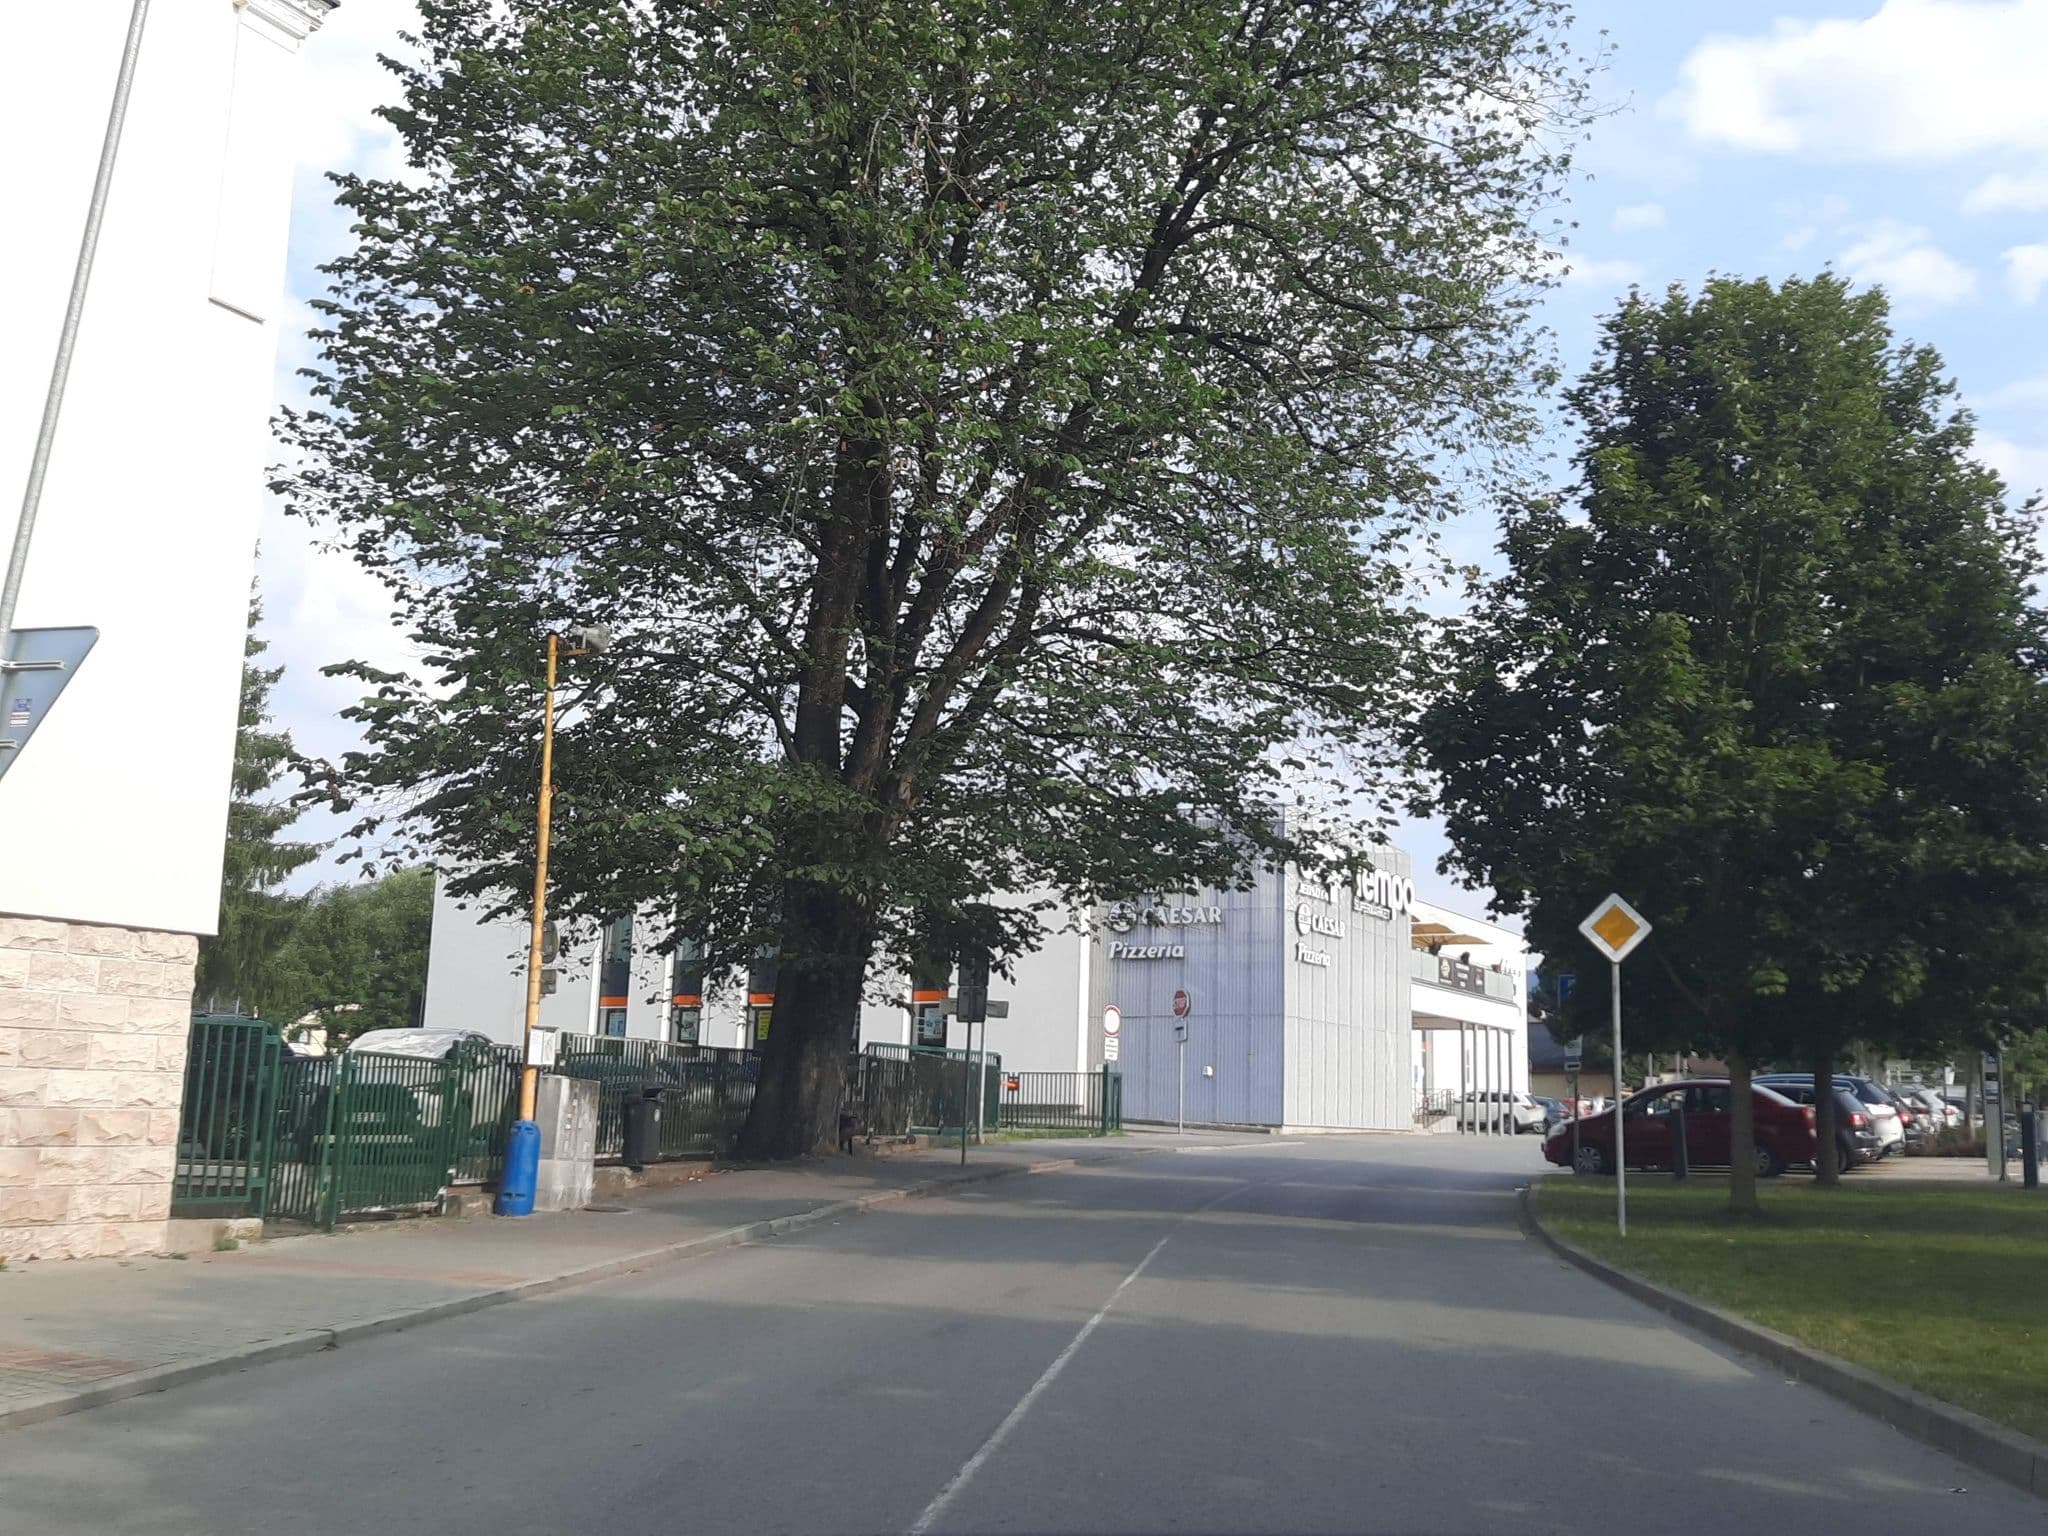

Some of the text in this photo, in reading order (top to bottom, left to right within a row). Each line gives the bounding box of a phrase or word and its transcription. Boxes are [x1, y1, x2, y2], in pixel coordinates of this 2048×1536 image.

[1312, 914, 1346, 938] CAESAR
[1108, 940, 1185, 959] Pizzeria
[1298, 942, 1331, 967] Pizzeria
